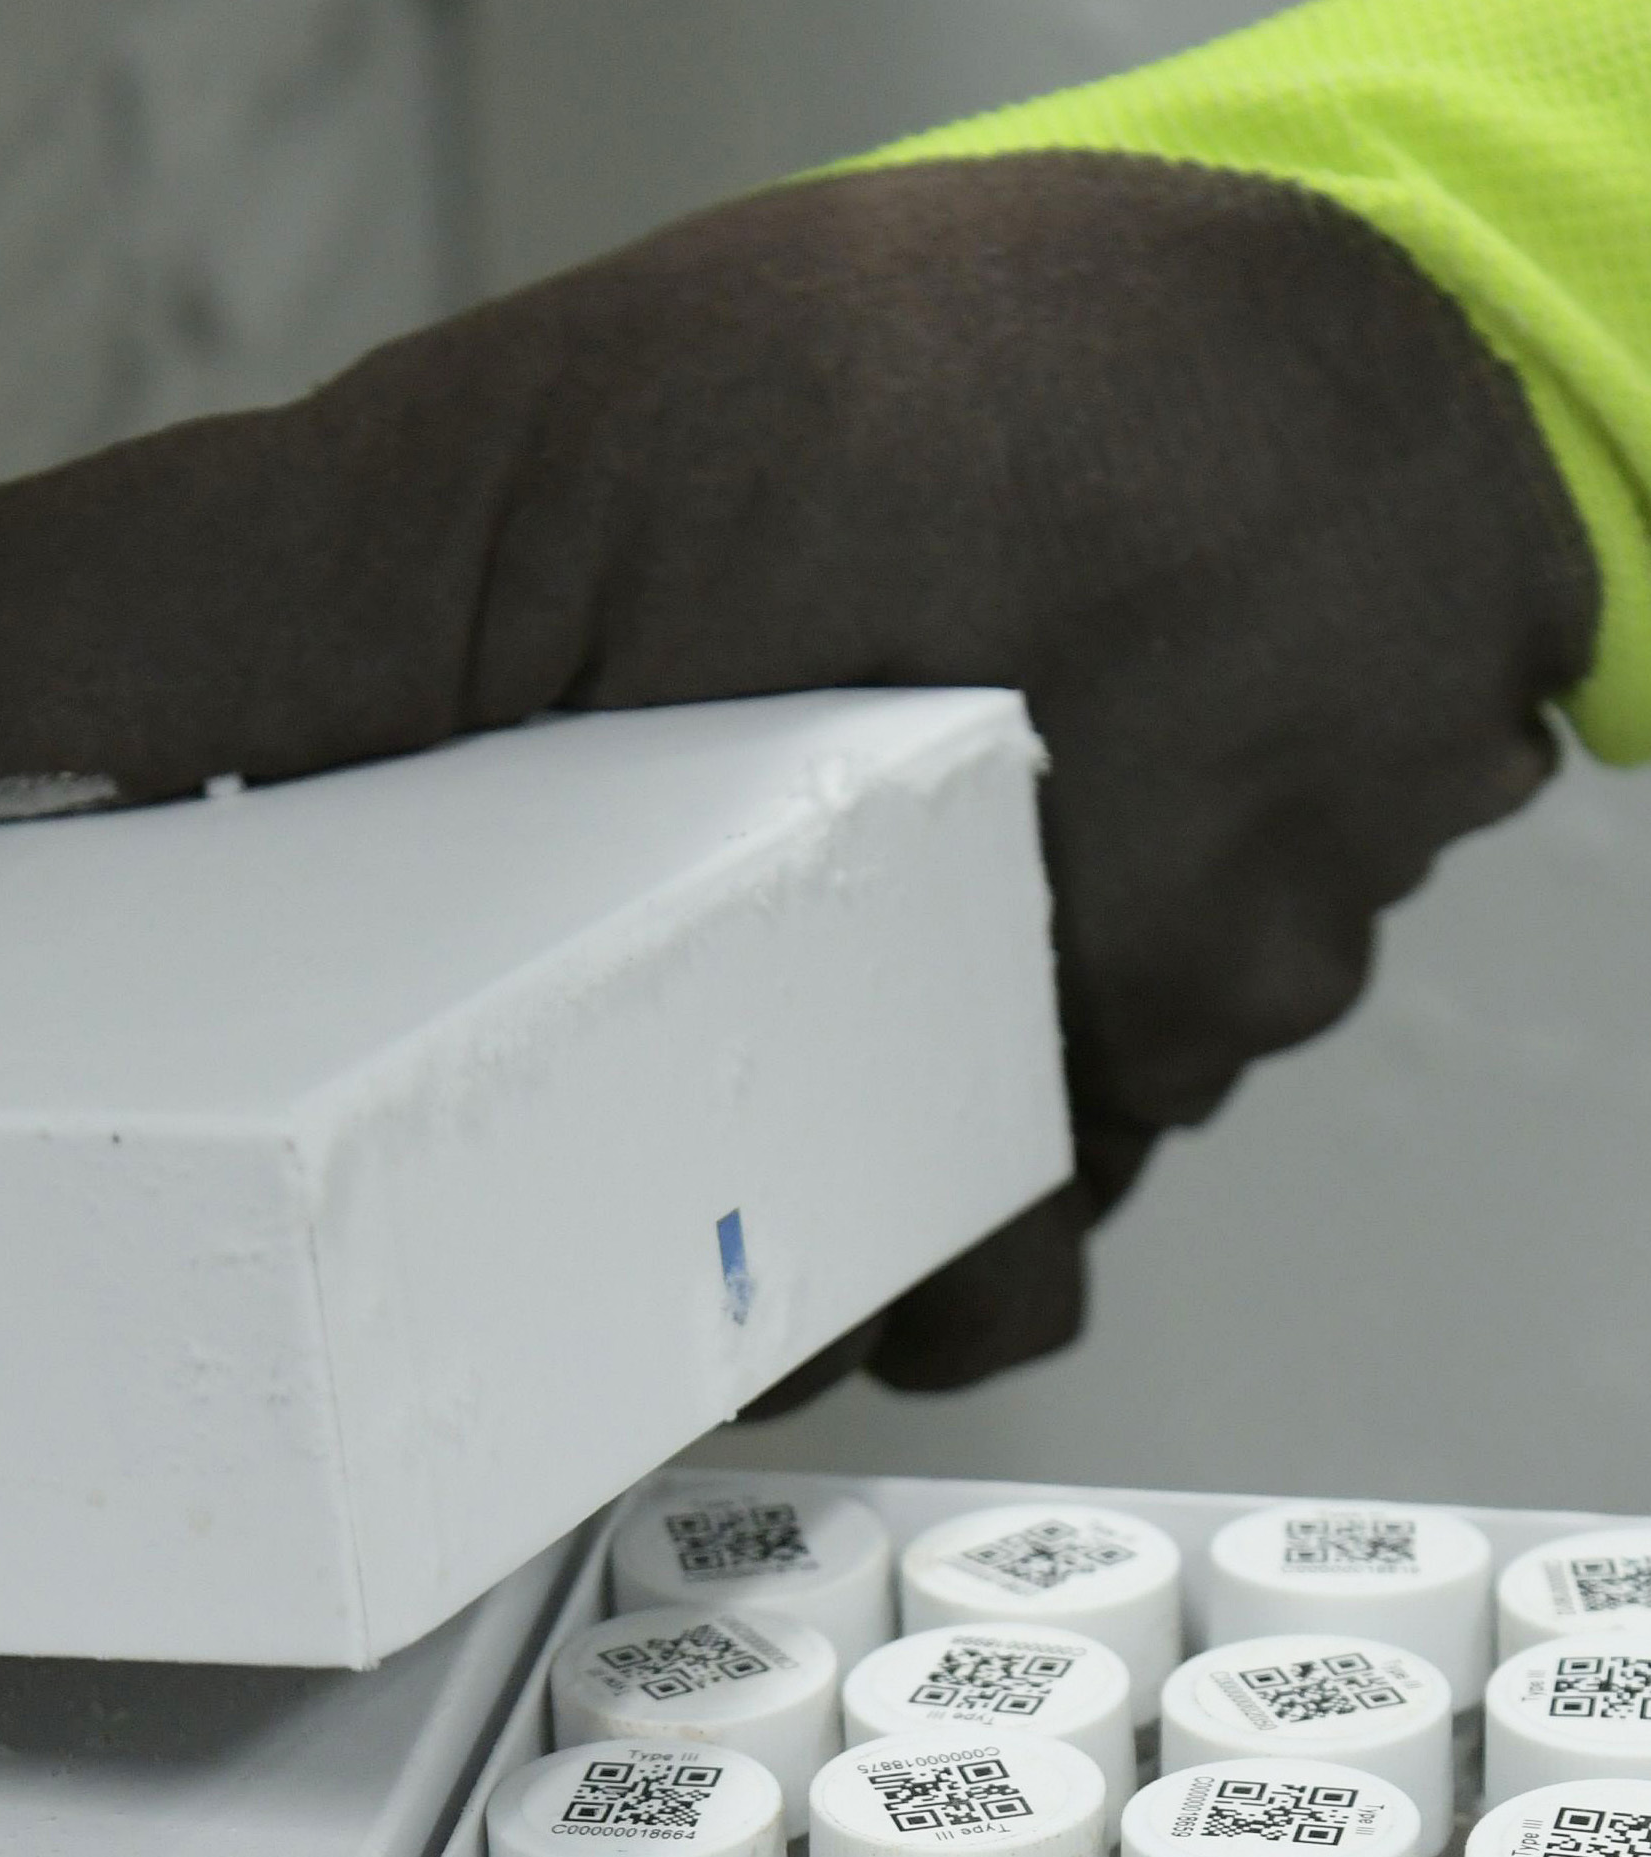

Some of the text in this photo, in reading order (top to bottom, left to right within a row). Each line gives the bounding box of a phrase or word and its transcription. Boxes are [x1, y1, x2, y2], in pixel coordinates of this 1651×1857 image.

[1521, 1670, 1546, 1702] Type III
[926, 1709, 994, 1725] Type III
[628, 1749, 699, 1762] Type III
[857, 1747, 1000, 1774] C00000018875
[1171, 1777, 1215, 1837] C00000018659
[1355, 1805, 1385, 1835] Type III
[551, 1824, 695, 1839] C00000018664
[935, 1823, 1011, 1841] Type III
[1511, 1819, 1543, 1856] Type III
